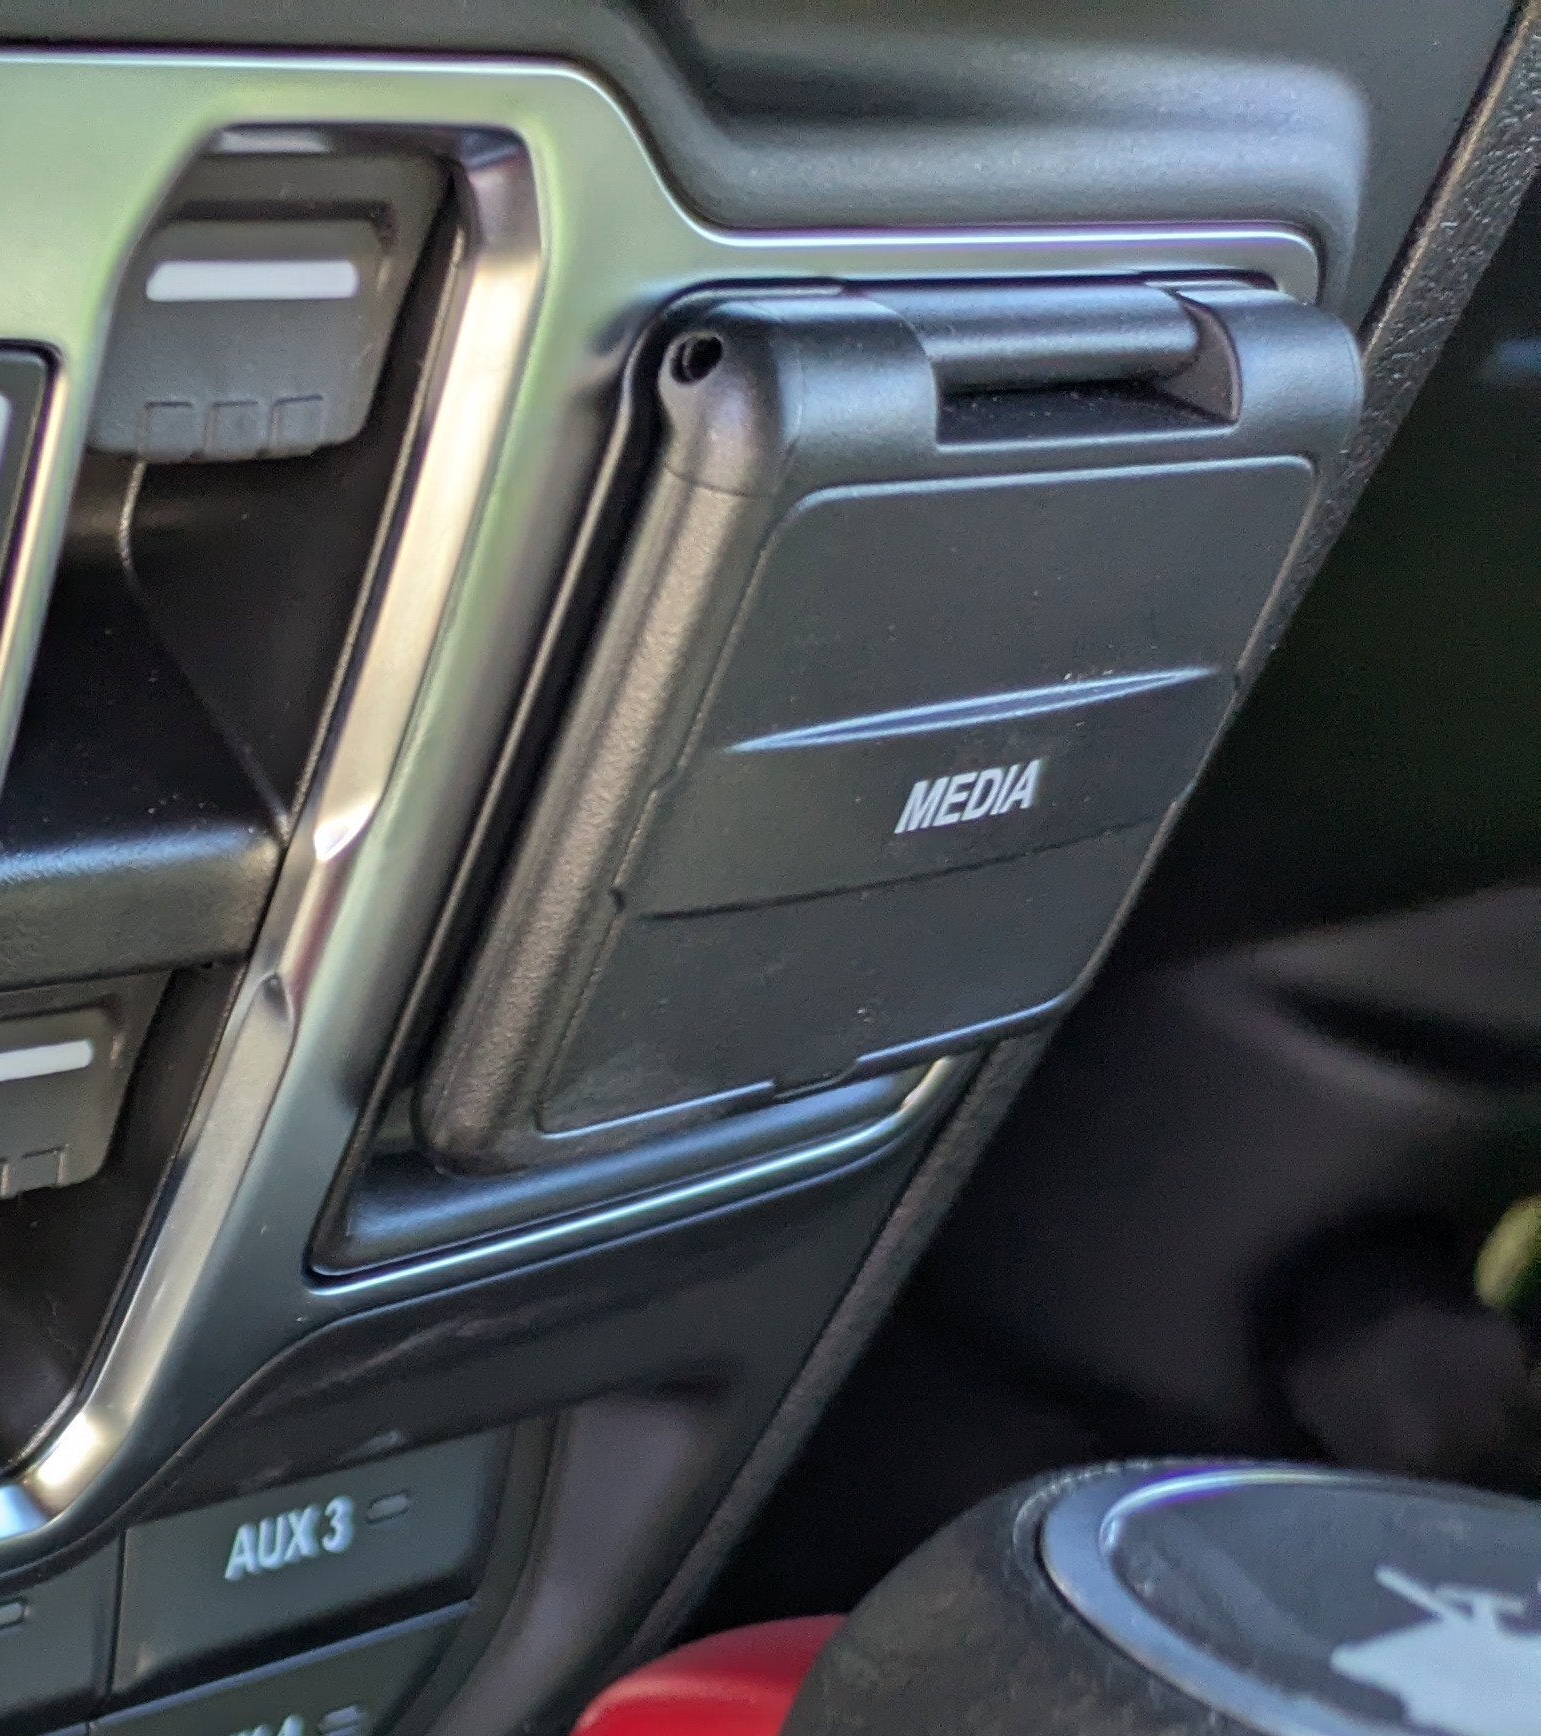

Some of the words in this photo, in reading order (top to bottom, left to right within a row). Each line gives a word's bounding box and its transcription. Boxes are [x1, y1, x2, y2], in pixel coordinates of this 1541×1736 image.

[895, 760, 1043, 834] MEDIA
[225, 1505, 319, 1580] AUX
[321, 1495, 354, 1553] 3
